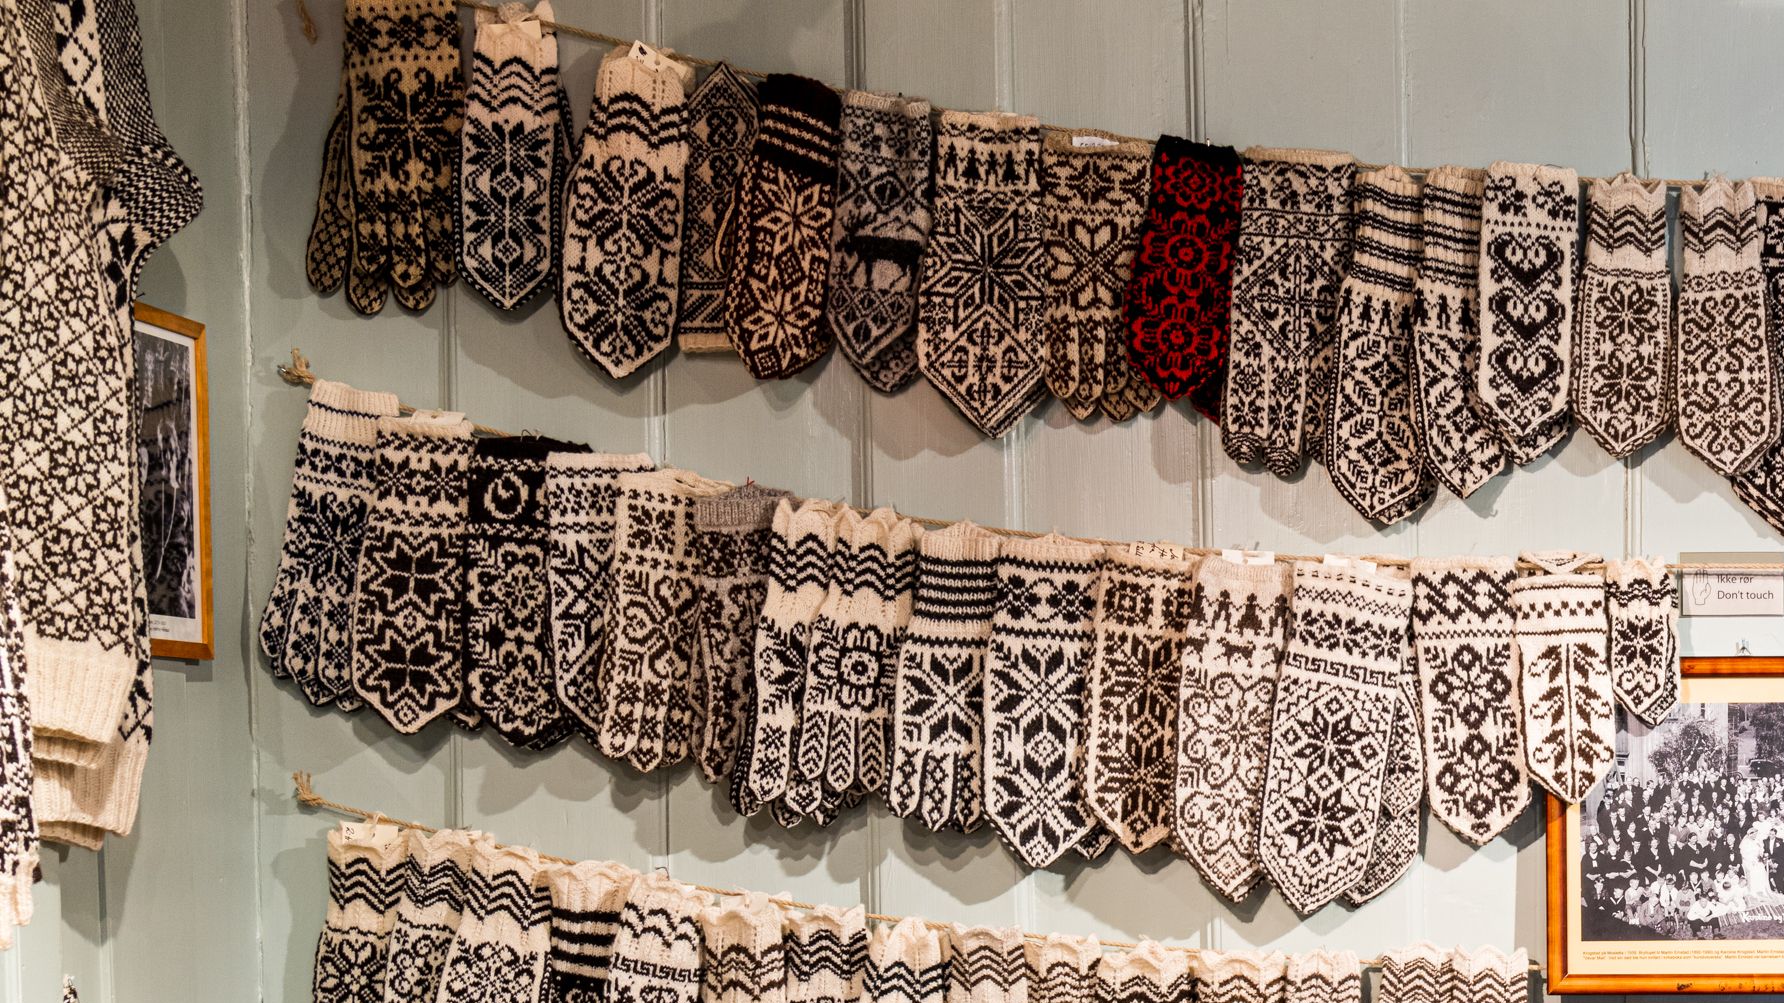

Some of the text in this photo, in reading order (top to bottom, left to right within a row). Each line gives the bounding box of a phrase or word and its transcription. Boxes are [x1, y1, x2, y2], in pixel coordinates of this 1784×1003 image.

[1717, 575, 1754, 584] Ikke rør
[1717, 590, 1774, 600] Don't touch
